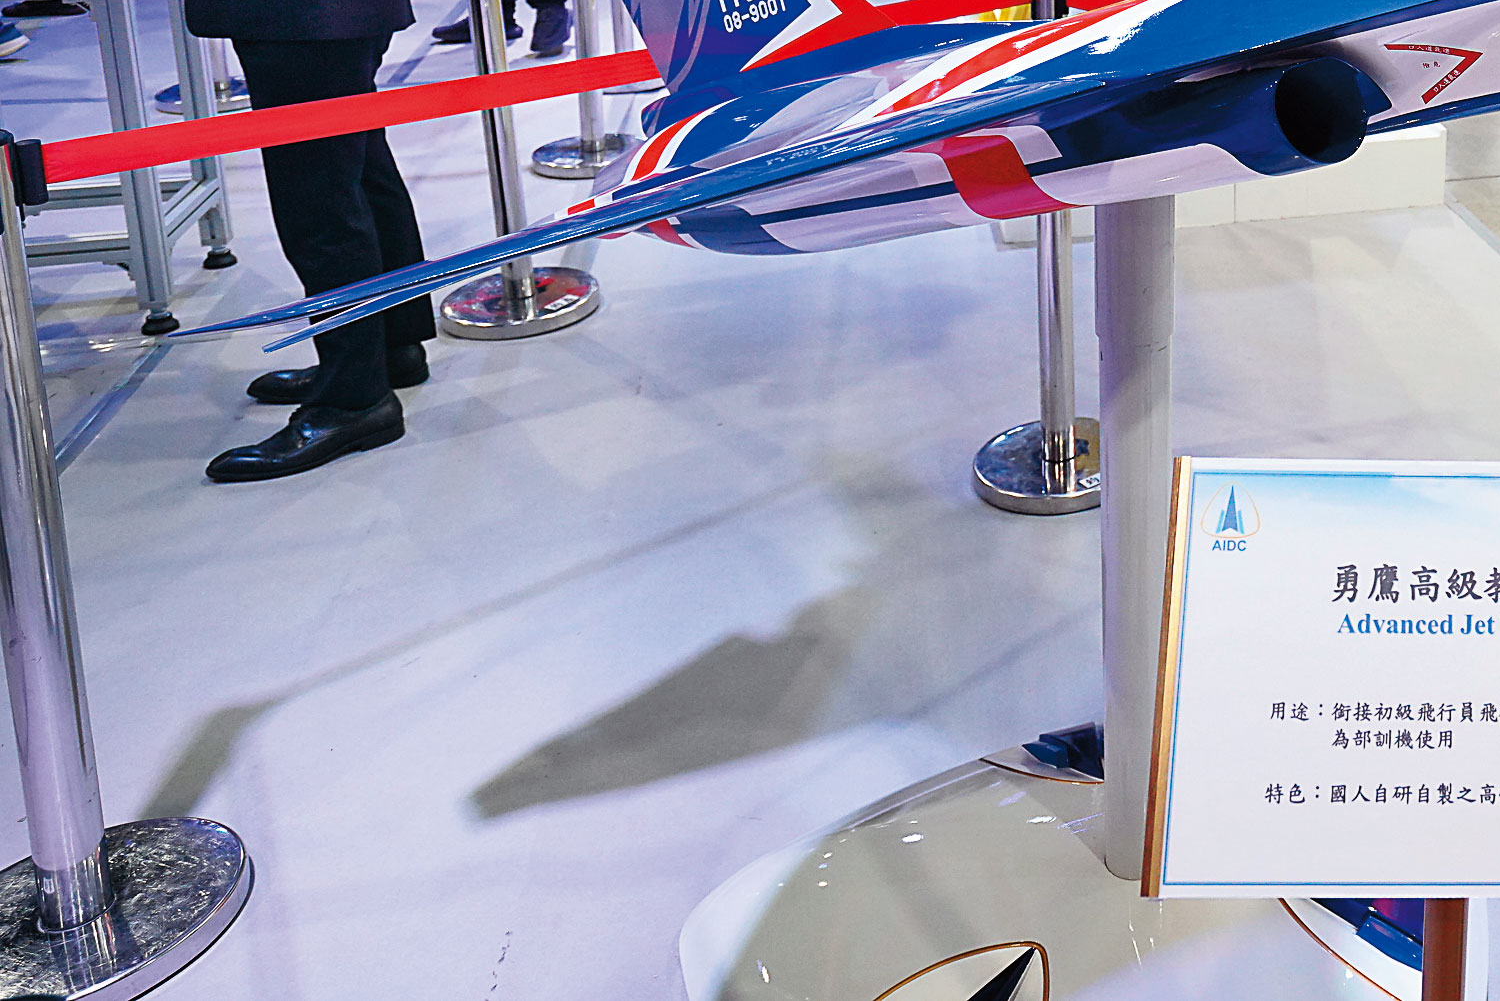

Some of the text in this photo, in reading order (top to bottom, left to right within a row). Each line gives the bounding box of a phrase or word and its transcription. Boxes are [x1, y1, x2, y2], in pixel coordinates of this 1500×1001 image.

[1211, 539, 1248, 552] AIDC
[1337, 613, 1454, 636] Advanced
[1459, 613, 1496, 636] Jet
[1331, 729, 1455, 751] 為部訓機使用
